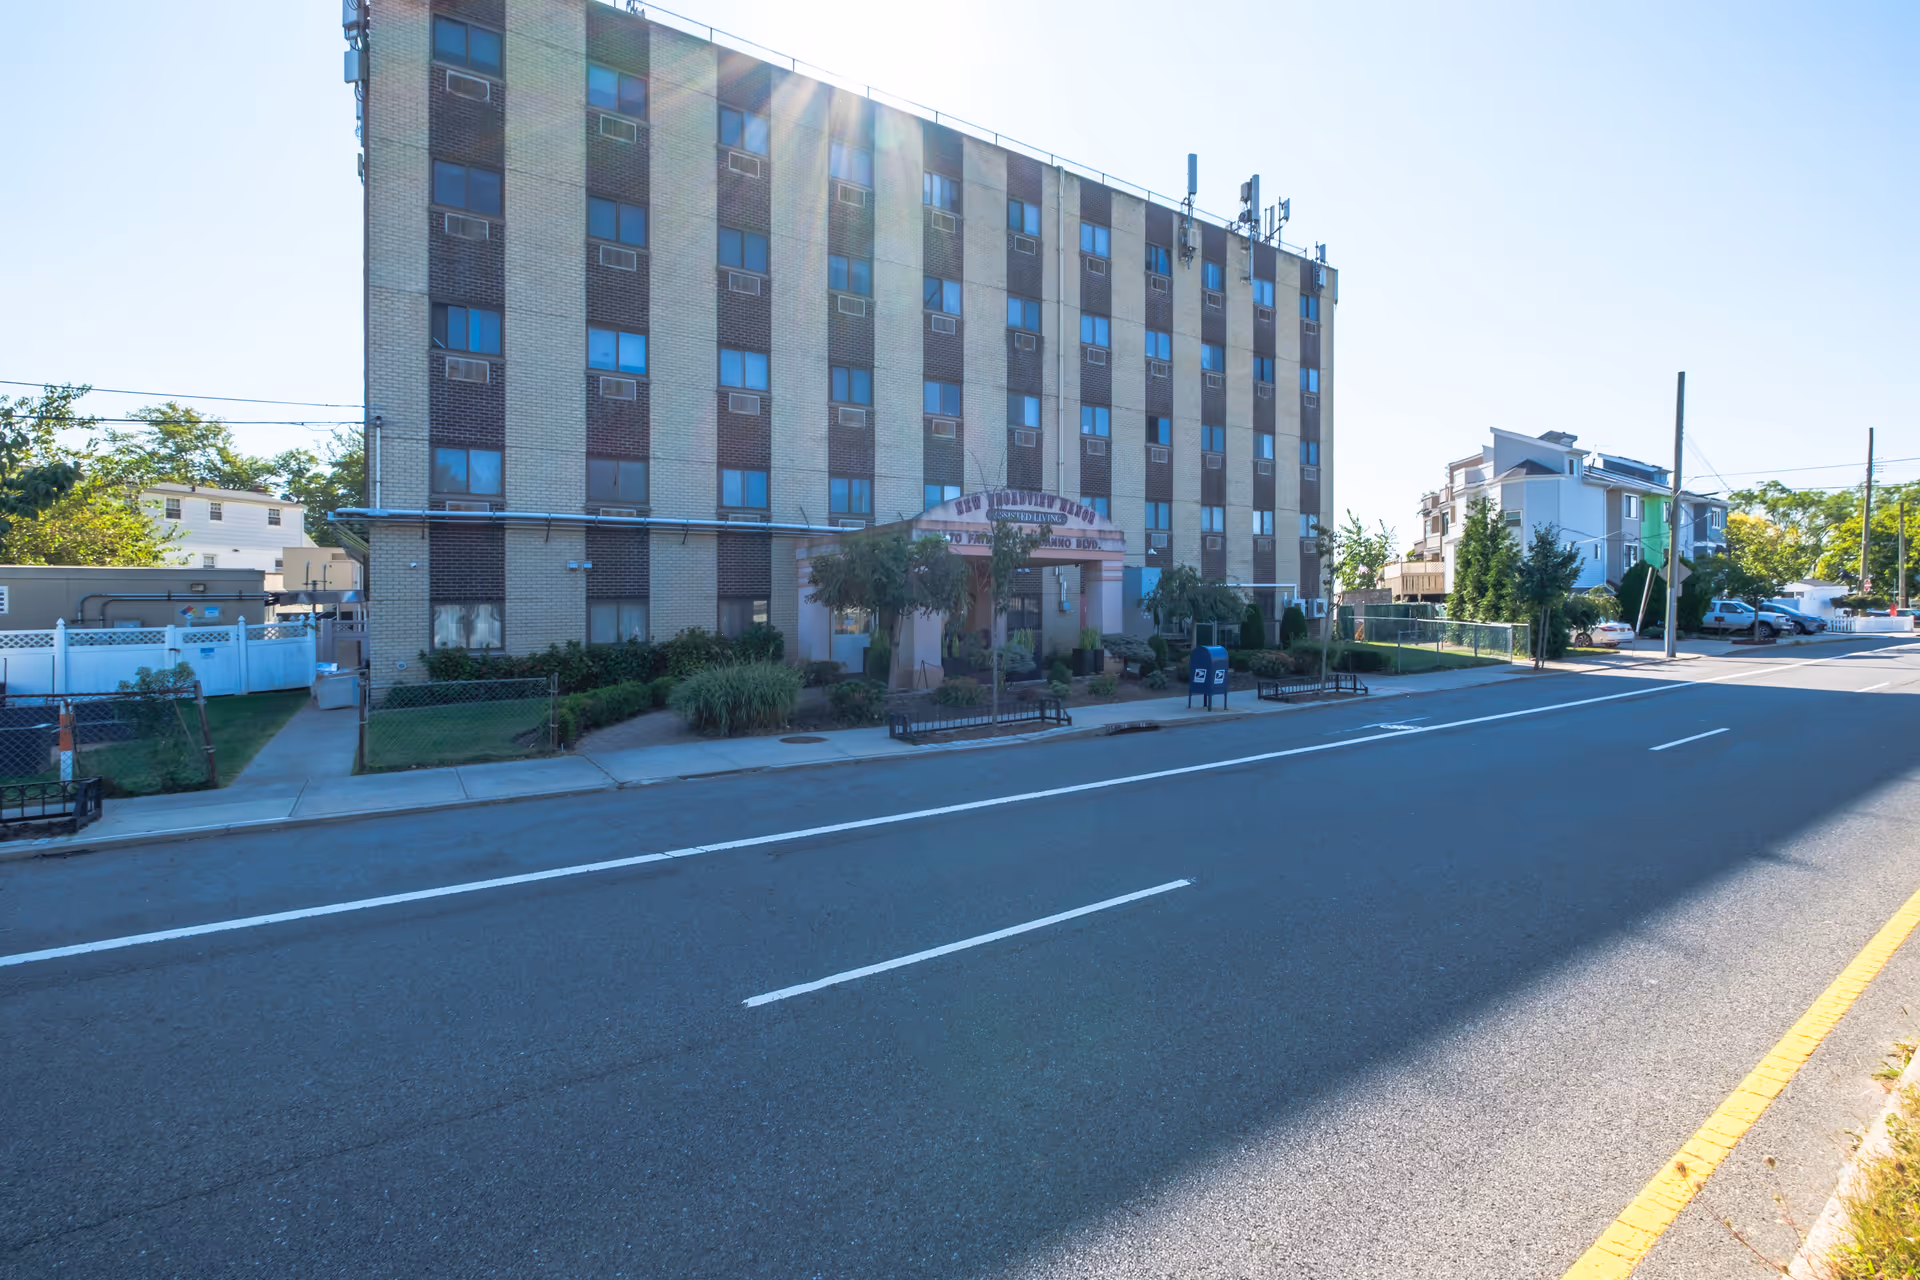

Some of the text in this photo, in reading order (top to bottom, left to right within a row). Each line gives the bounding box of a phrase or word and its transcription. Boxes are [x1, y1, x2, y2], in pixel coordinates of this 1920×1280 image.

[954, 495, 981, 516] NEW
[1059, 497, 1096, 526] MANOR
[1076, 538, 1102, 550] BLVD.
